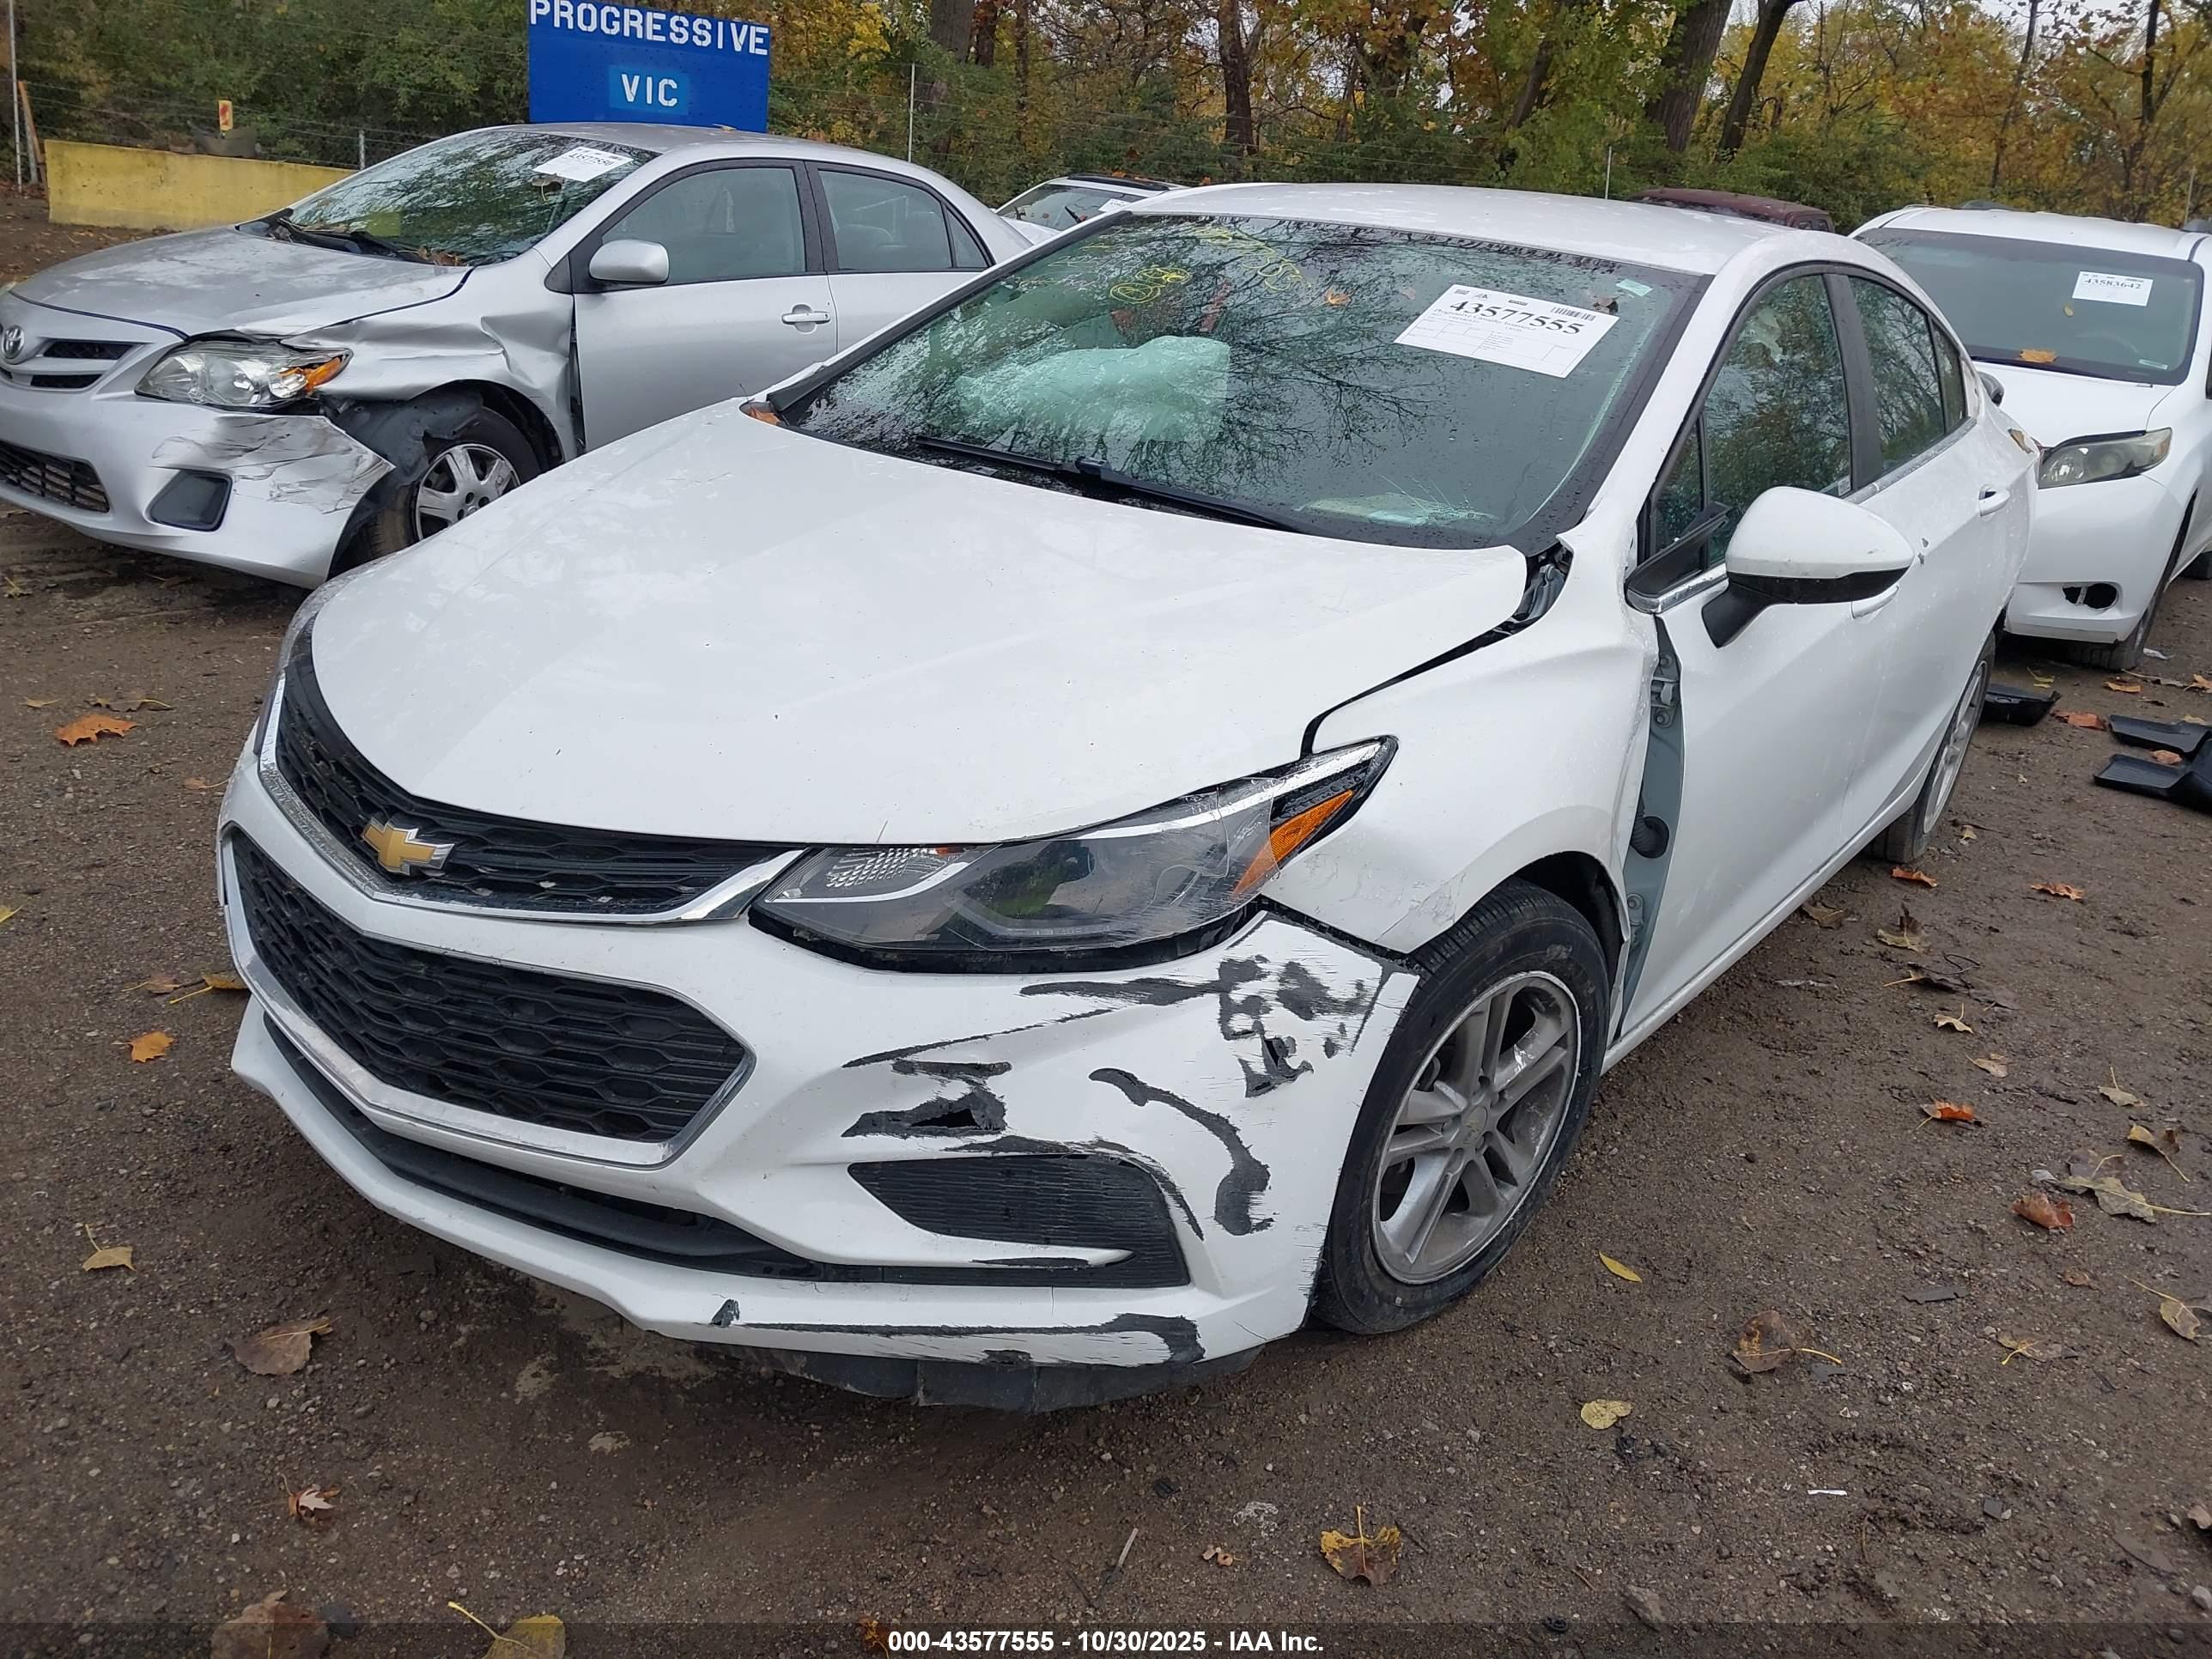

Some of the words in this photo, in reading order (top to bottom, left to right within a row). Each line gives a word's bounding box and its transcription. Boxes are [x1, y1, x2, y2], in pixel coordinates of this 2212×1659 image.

[530, 0, 769, 56] PROGRESSIVE
[622, 74, 678, 107] VIC
[1449, 301, 1585, 335] 43577555
